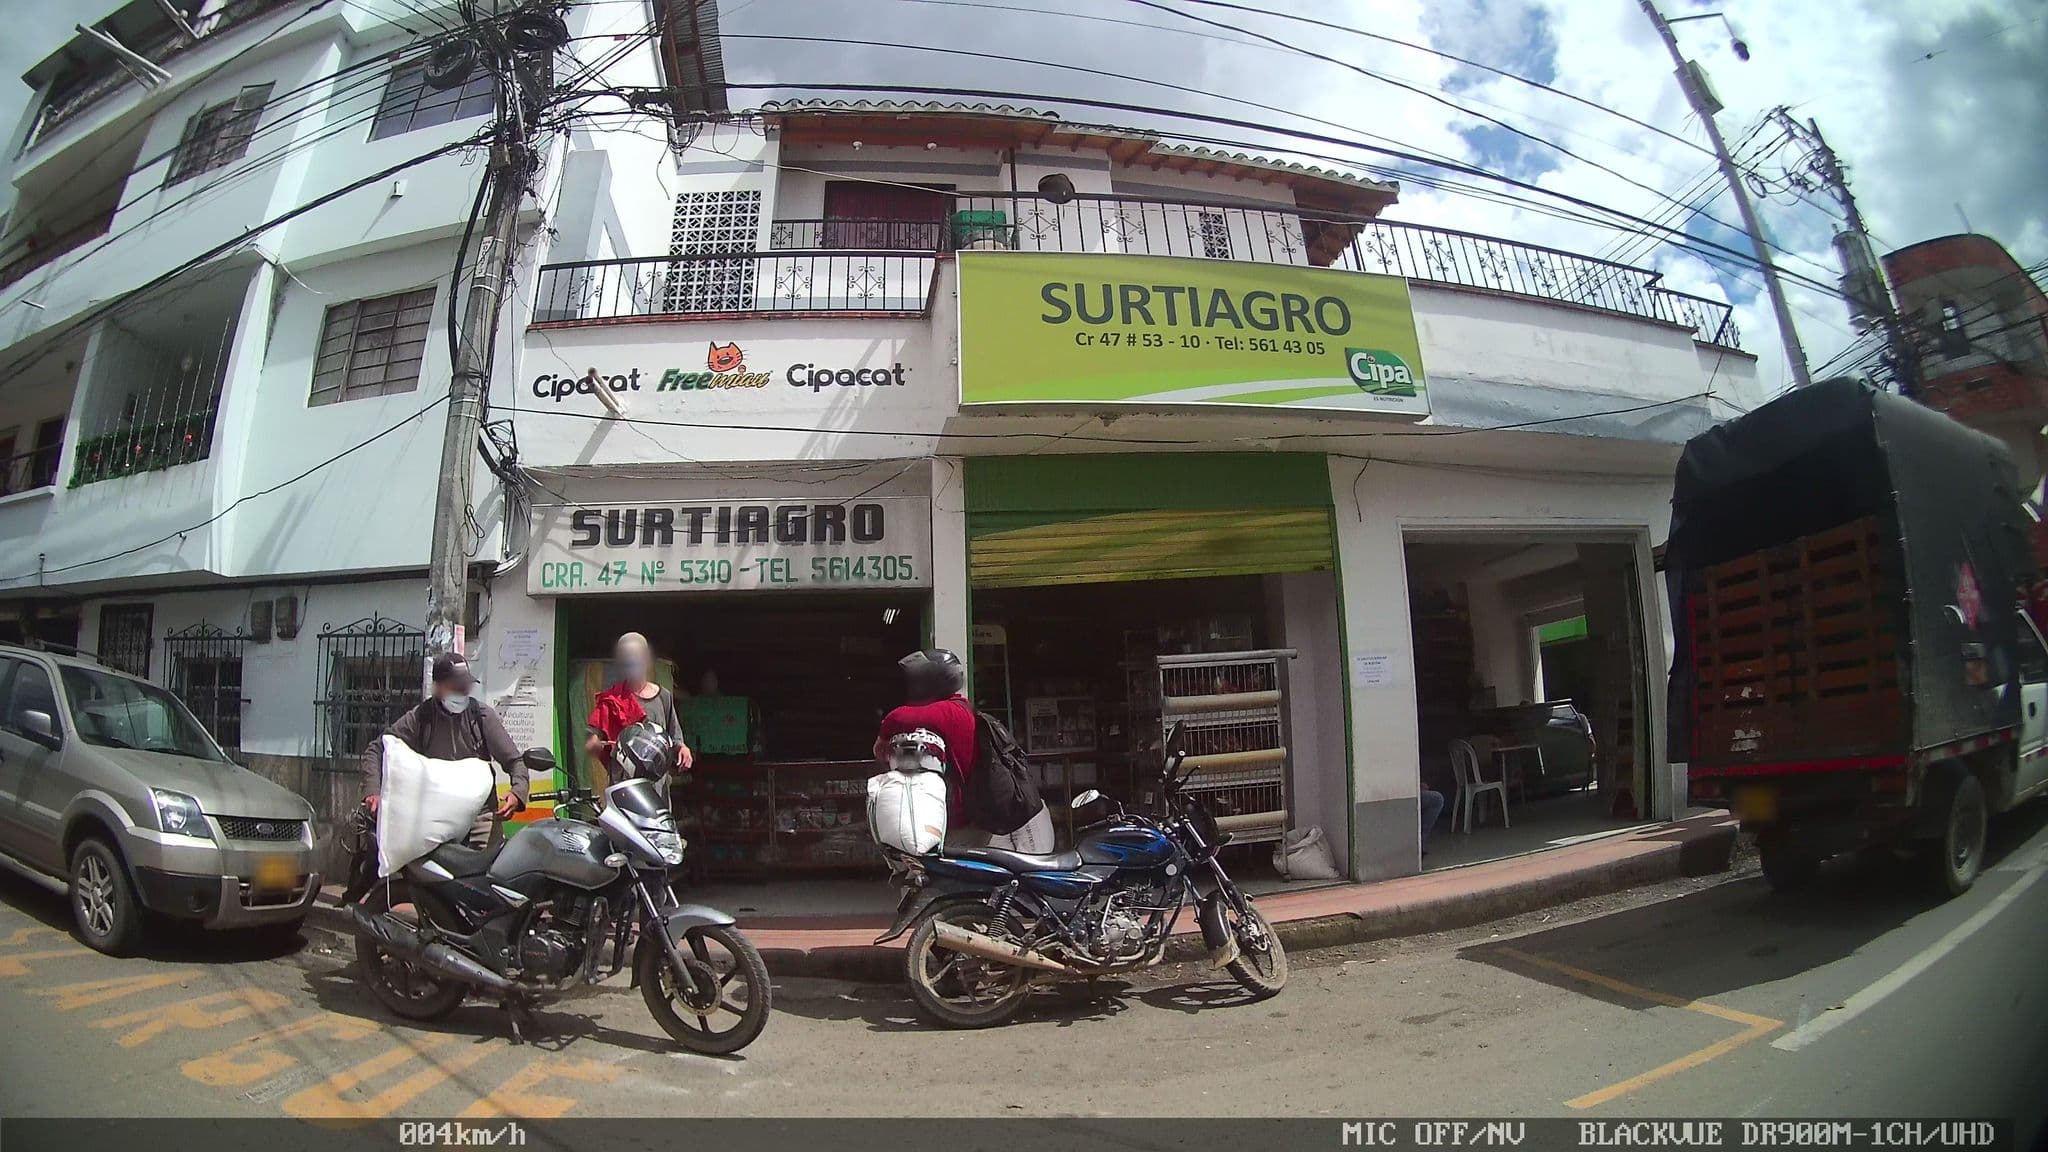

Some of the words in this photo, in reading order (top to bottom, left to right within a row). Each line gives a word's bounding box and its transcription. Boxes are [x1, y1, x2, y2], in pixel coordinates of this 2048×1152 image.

[1040, 281, 1352, 336] SURTIAGRO
[1075, 332, 1094, 346] Cr
[1099, 333, 1120, 346] 47
[1126, 333, 1137, 346] #
[1142, 333, 1163, 347] 53
[1180, 335, 1200, 348] 10
[1215, 336, 1244, 351] Tel:
[1249, 338, 1278, 352] 561
[1283, 340, 1302, 353] 43
[1306, 342, 1325, 355] 05
[533, 368, 640, 402] Cipaat
[786, 363, 906, 392] Cipacat
[1350, 352, 1412, 389] Cipa
[571, 504, 885, 547] SURTIAGRO
[541, 562, 587, 588] CRA.
[598, 561, 627, 586] 47
[679, 559, 731, 584] 5310
[755, 558, 798, 583] TEL
[811, 555, 919, 583] 5614305.
